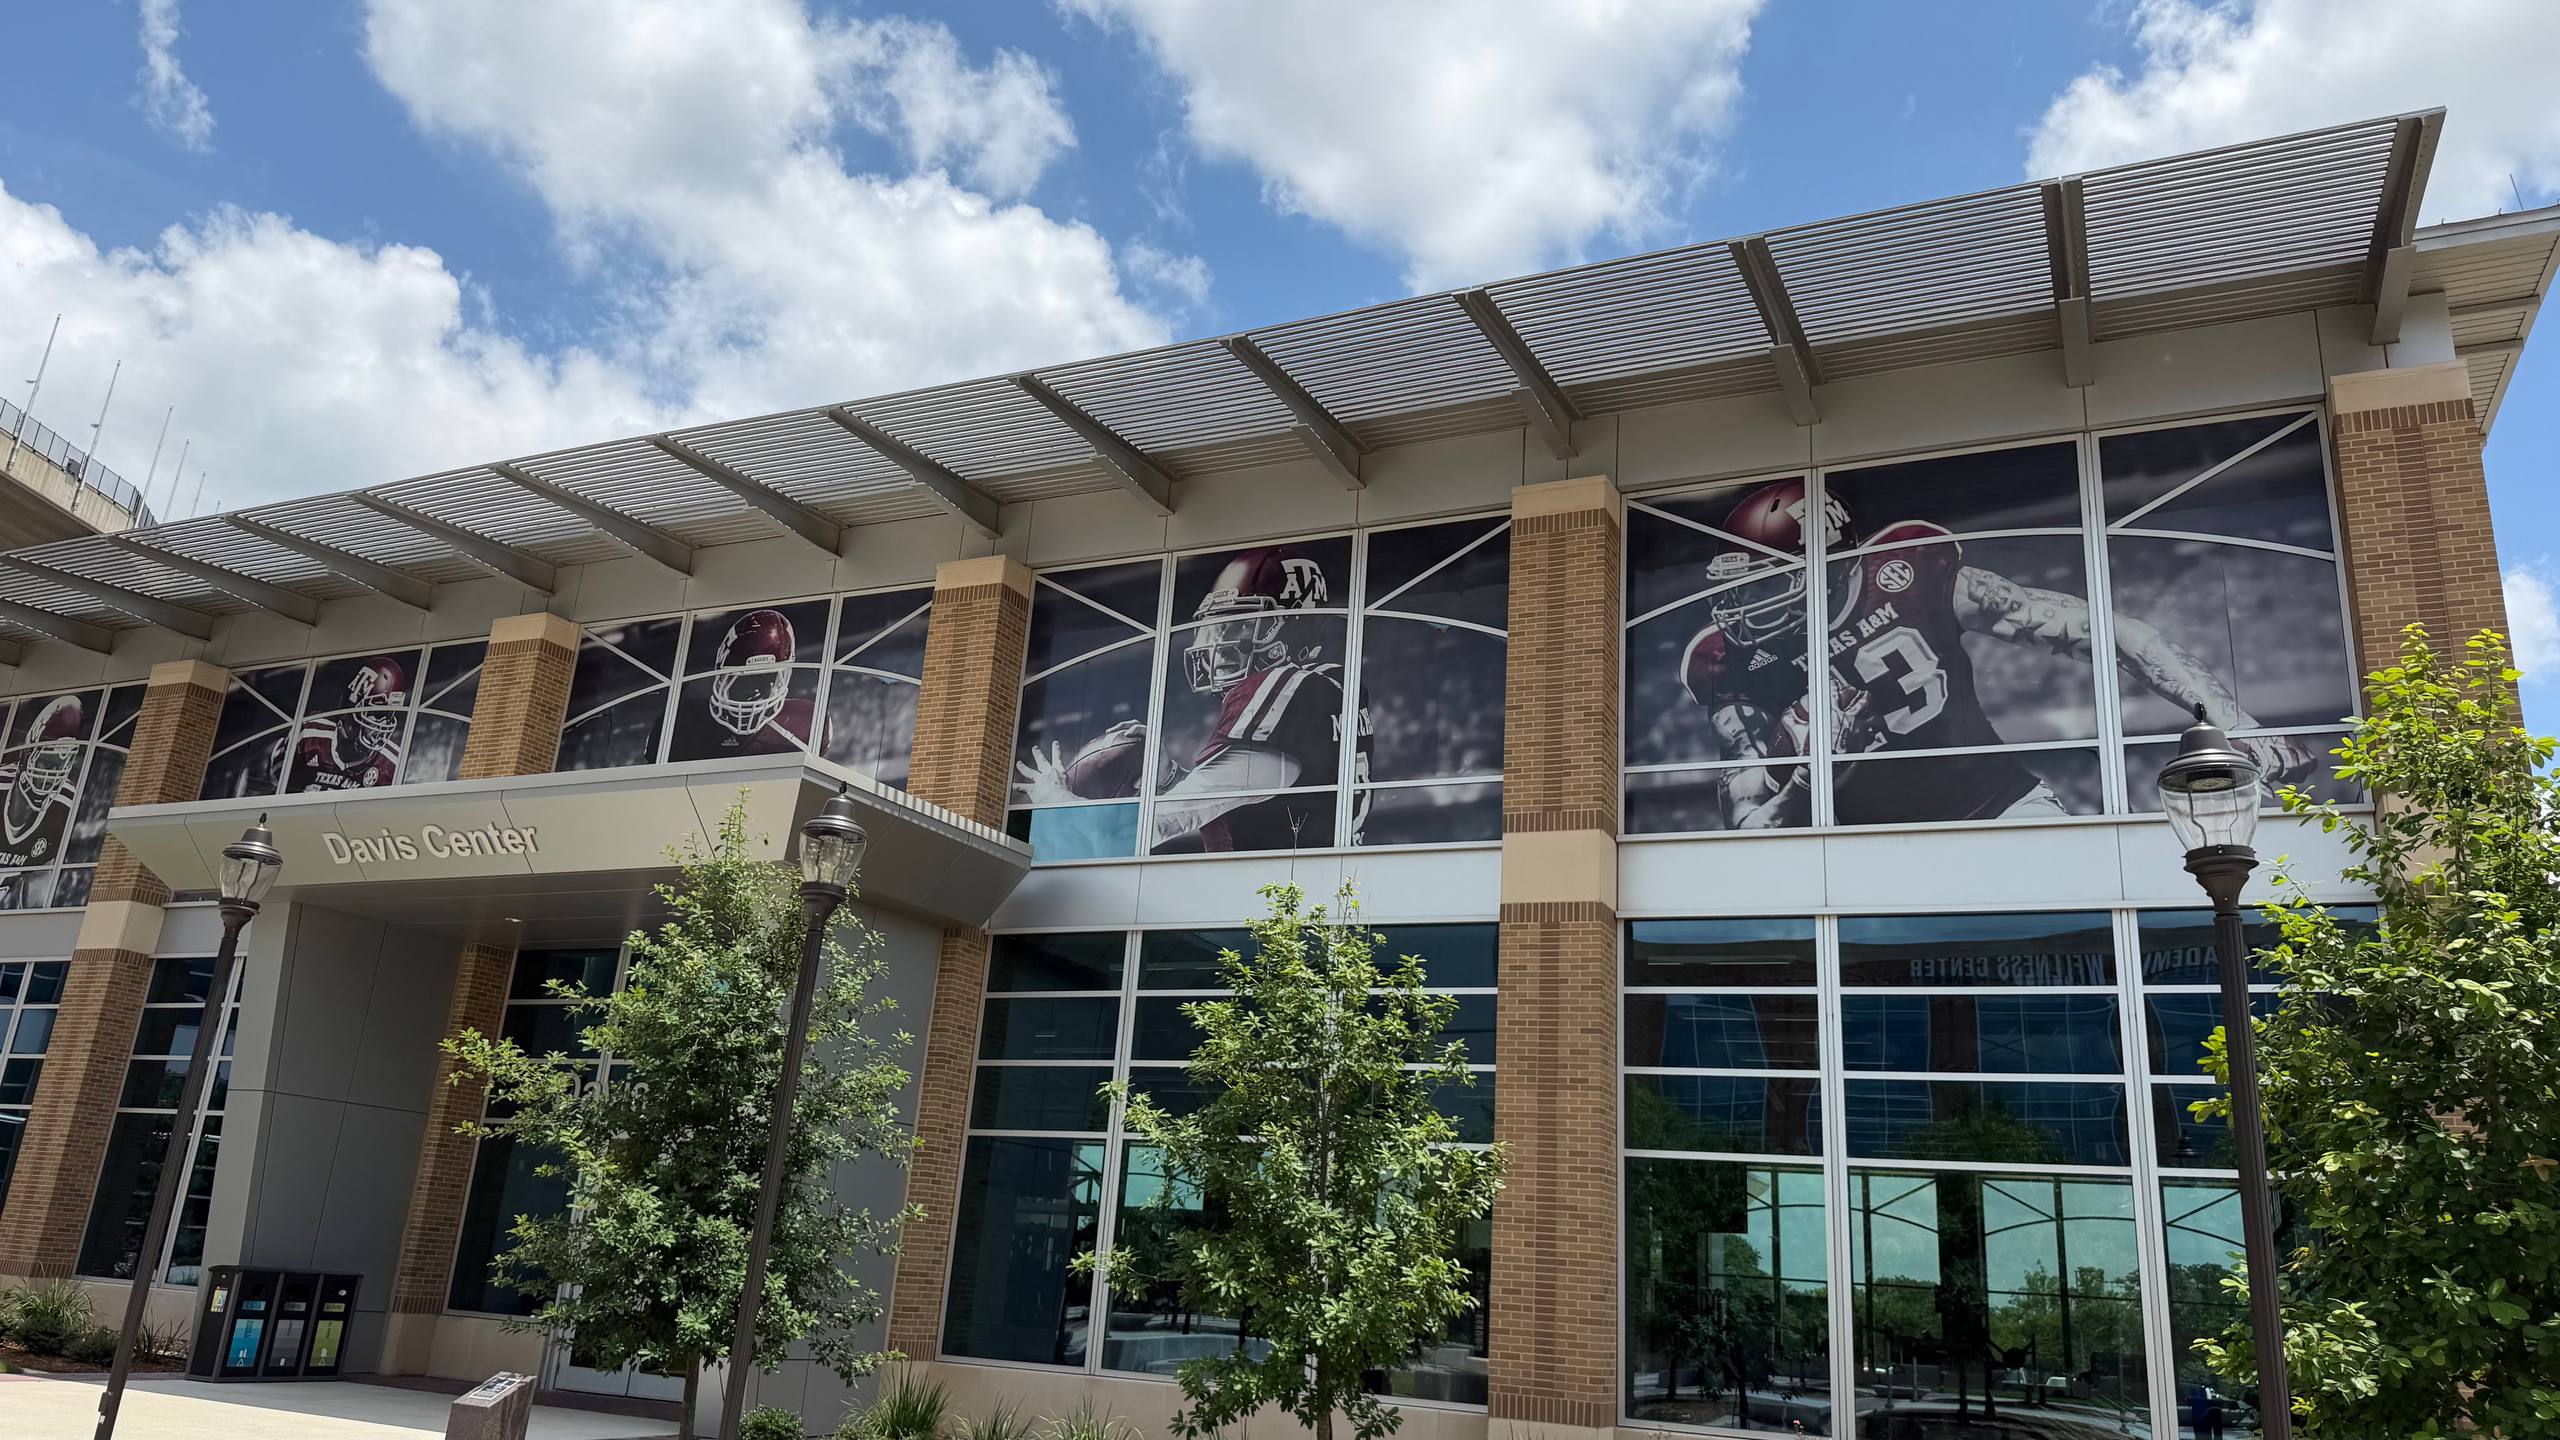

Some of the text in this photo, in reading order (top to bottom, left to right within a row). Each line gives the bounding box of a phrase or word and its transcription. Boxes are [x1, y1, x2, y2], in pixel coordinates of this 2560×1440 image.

[1881, 560, 1912, 591] SEC
[1791, 601, 1899, 672] TAS A&M
[1748, 653, 1779, 672] adidas
[315, 771, 344, 786] TEXAS
[322, 821, 540, 864] Davis Center
